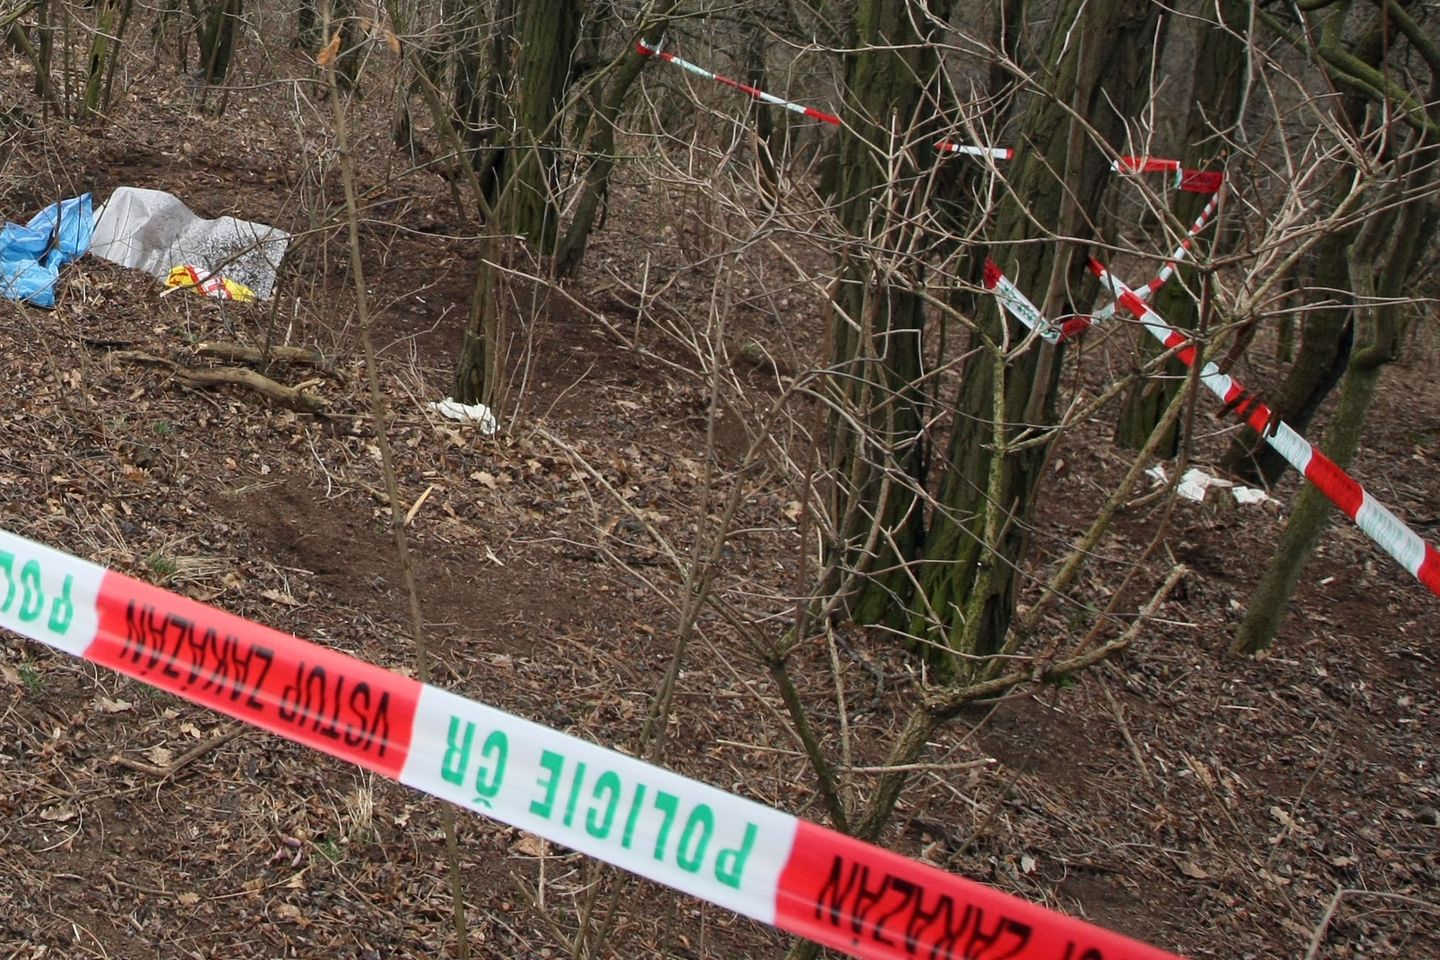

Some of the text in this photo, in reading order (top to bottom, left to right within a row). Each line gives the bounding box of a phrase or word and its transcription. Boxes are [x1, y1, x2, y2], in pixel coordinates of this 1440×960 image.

[120, 600, 390, 758] VSTUP ZAKÁZÁN
[439, 714, 761, 893] POLICIE ČR
